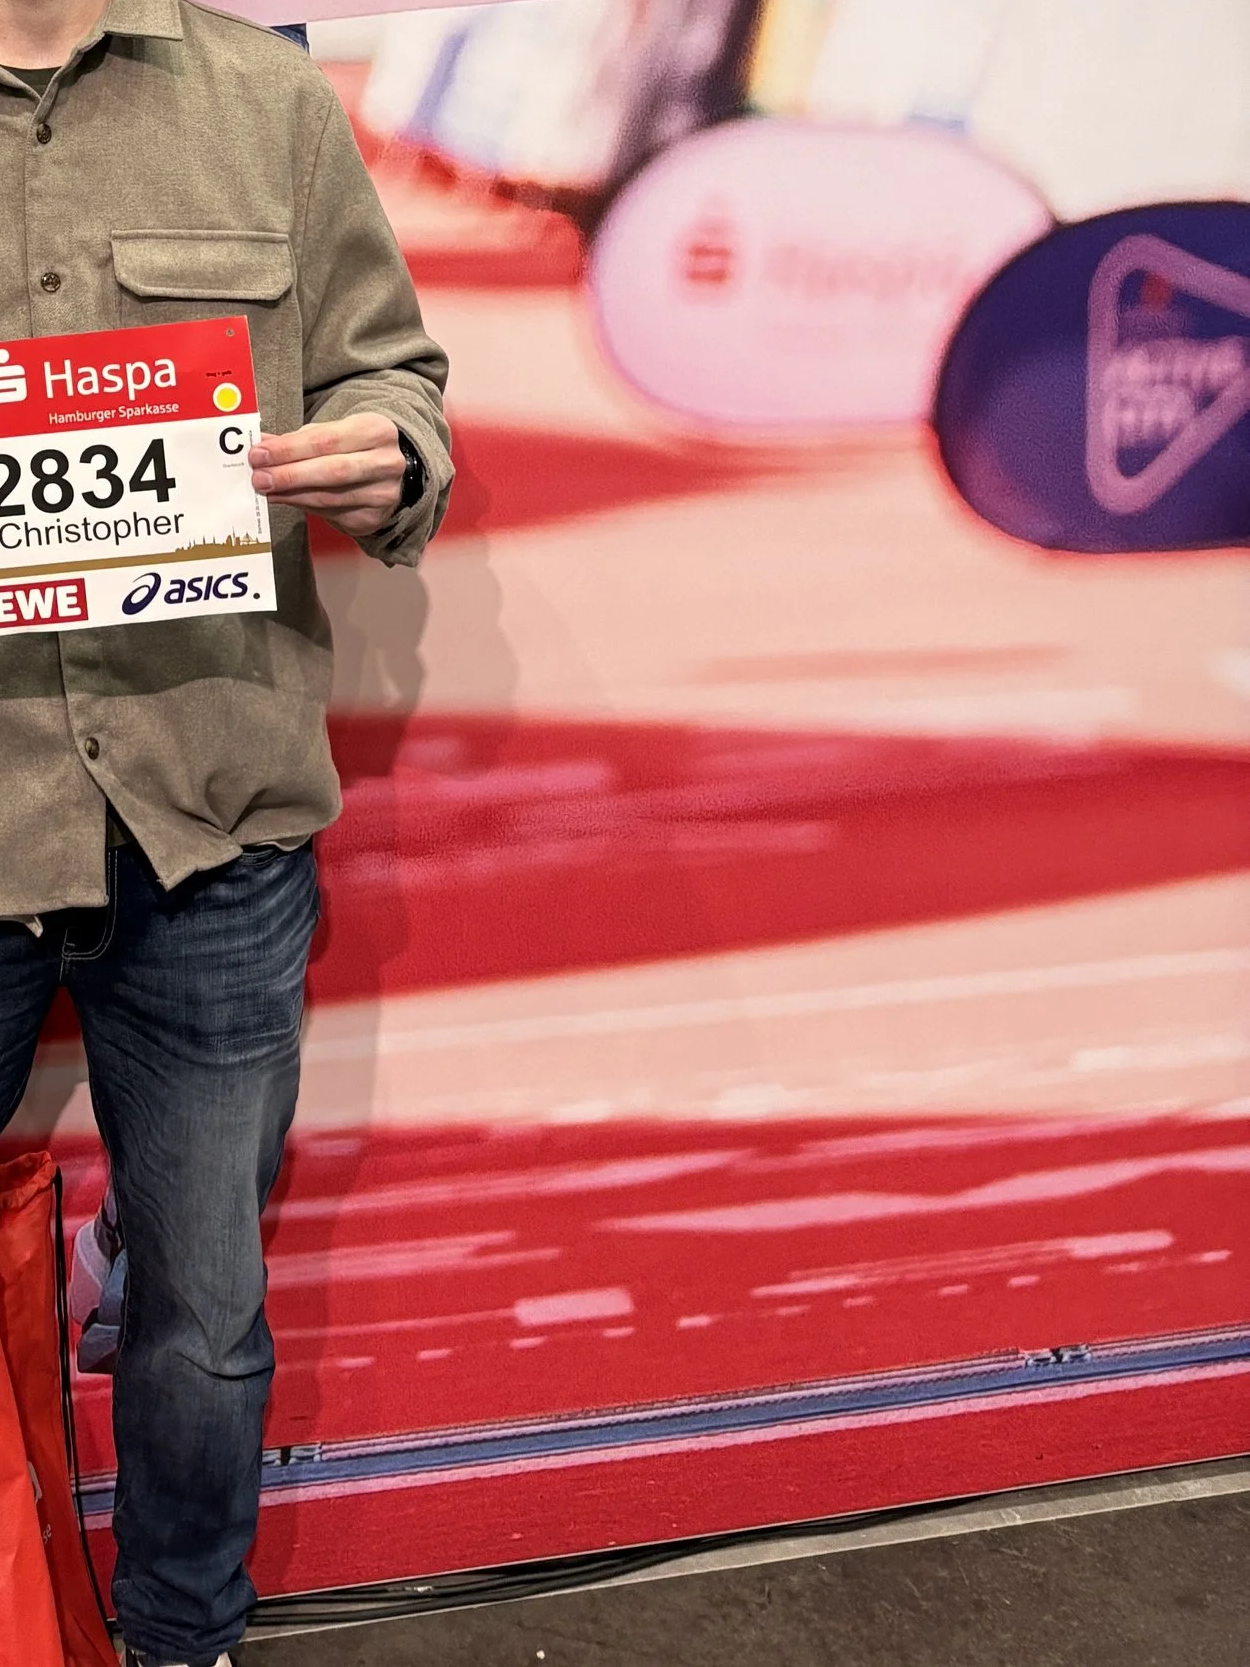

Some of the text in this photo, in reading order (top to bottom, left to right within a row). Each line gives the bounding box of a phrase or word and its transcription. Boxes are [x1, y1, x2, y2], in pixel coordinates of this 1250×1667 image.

[44, 357, 177, 401] Haspa
[49, 402, 179, 425] Hamburger Sparkasse
[219, 427, 244, 455] C
